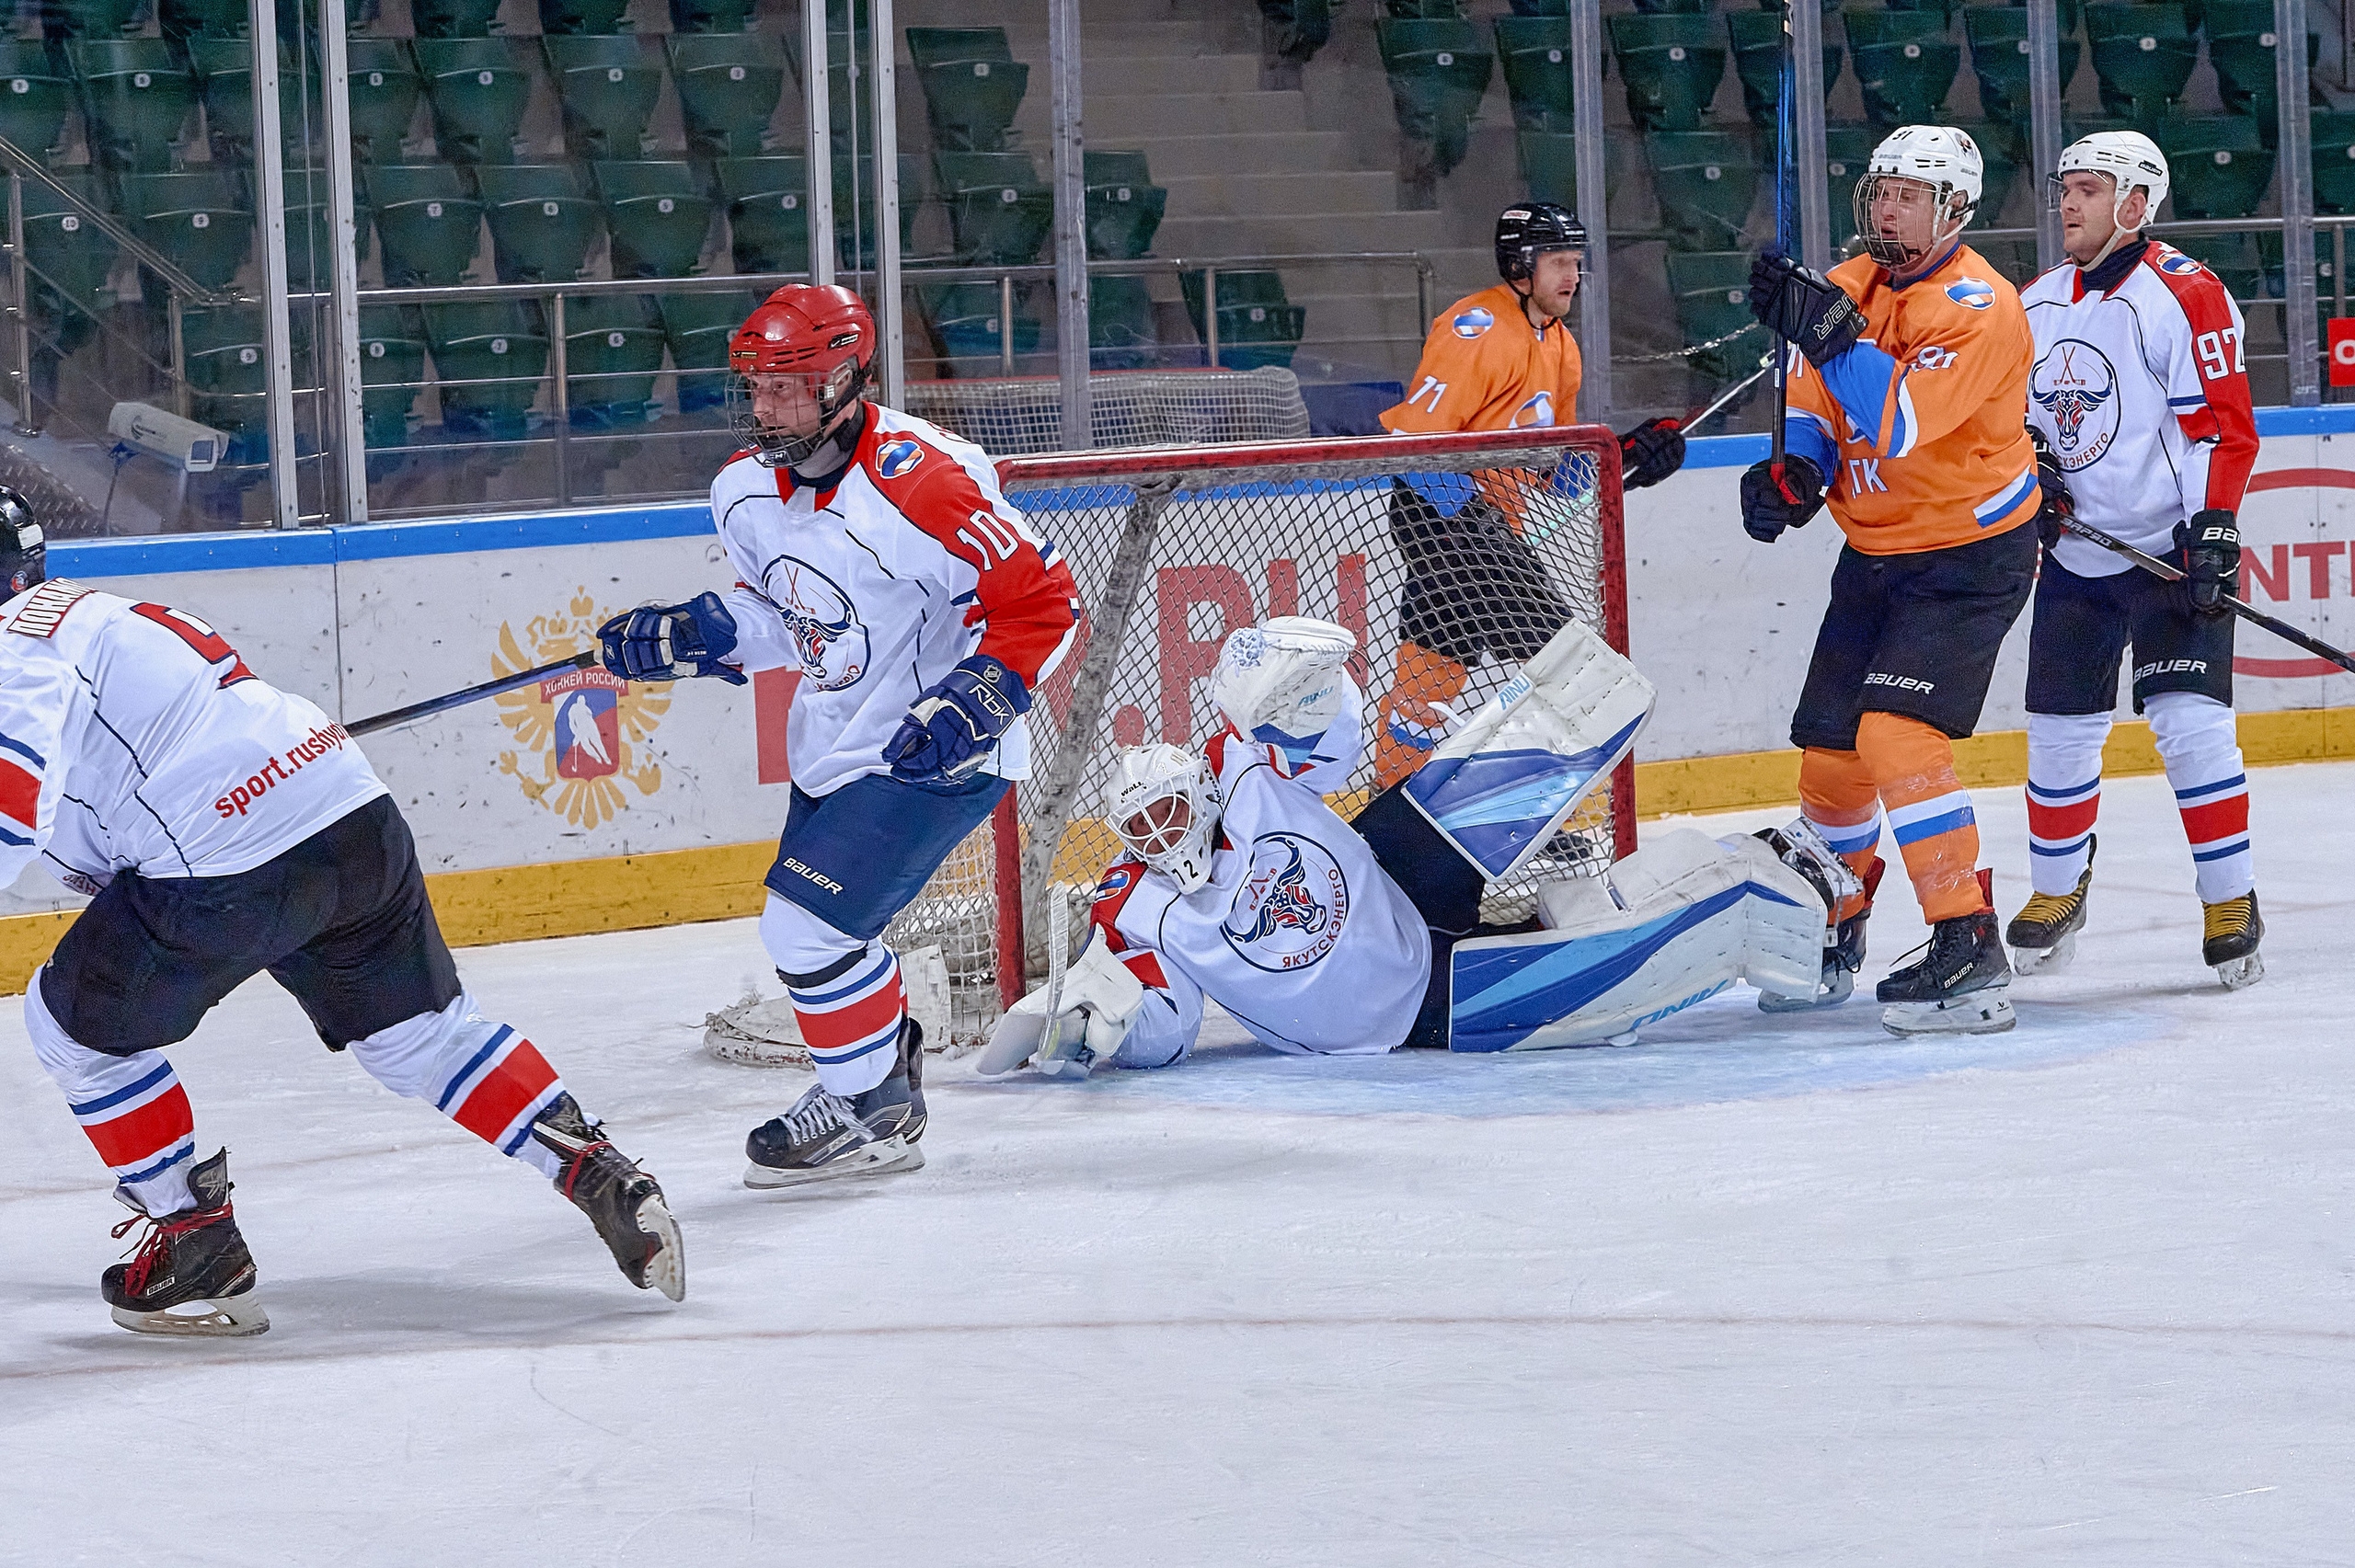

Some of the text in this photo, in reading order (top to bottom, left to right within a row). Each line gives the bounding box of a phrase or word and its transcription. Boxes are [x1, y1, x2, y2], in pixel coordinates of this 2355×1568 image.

[1813, 293, 1856, 339] UER
[2056, 432, 2108, 468] СКЭНЕРГО
[956, 509, 1019, 572] 10
[2237, 540, 2355, 604] NT
[546, 670, 626, 695] ХОККЕЙ РОССИИ
[1864, 672, 1935, 695] BAUER
[2133, 659, 2207, 684] BAUER
[783, 857, 844, 896] BAUER
[1171, 859, 1199, 886] 12
[1282, 869, 1345, 968] ЯКУТСКЭНЕРГО
[1944, 962, 1974, 990] BAUER
